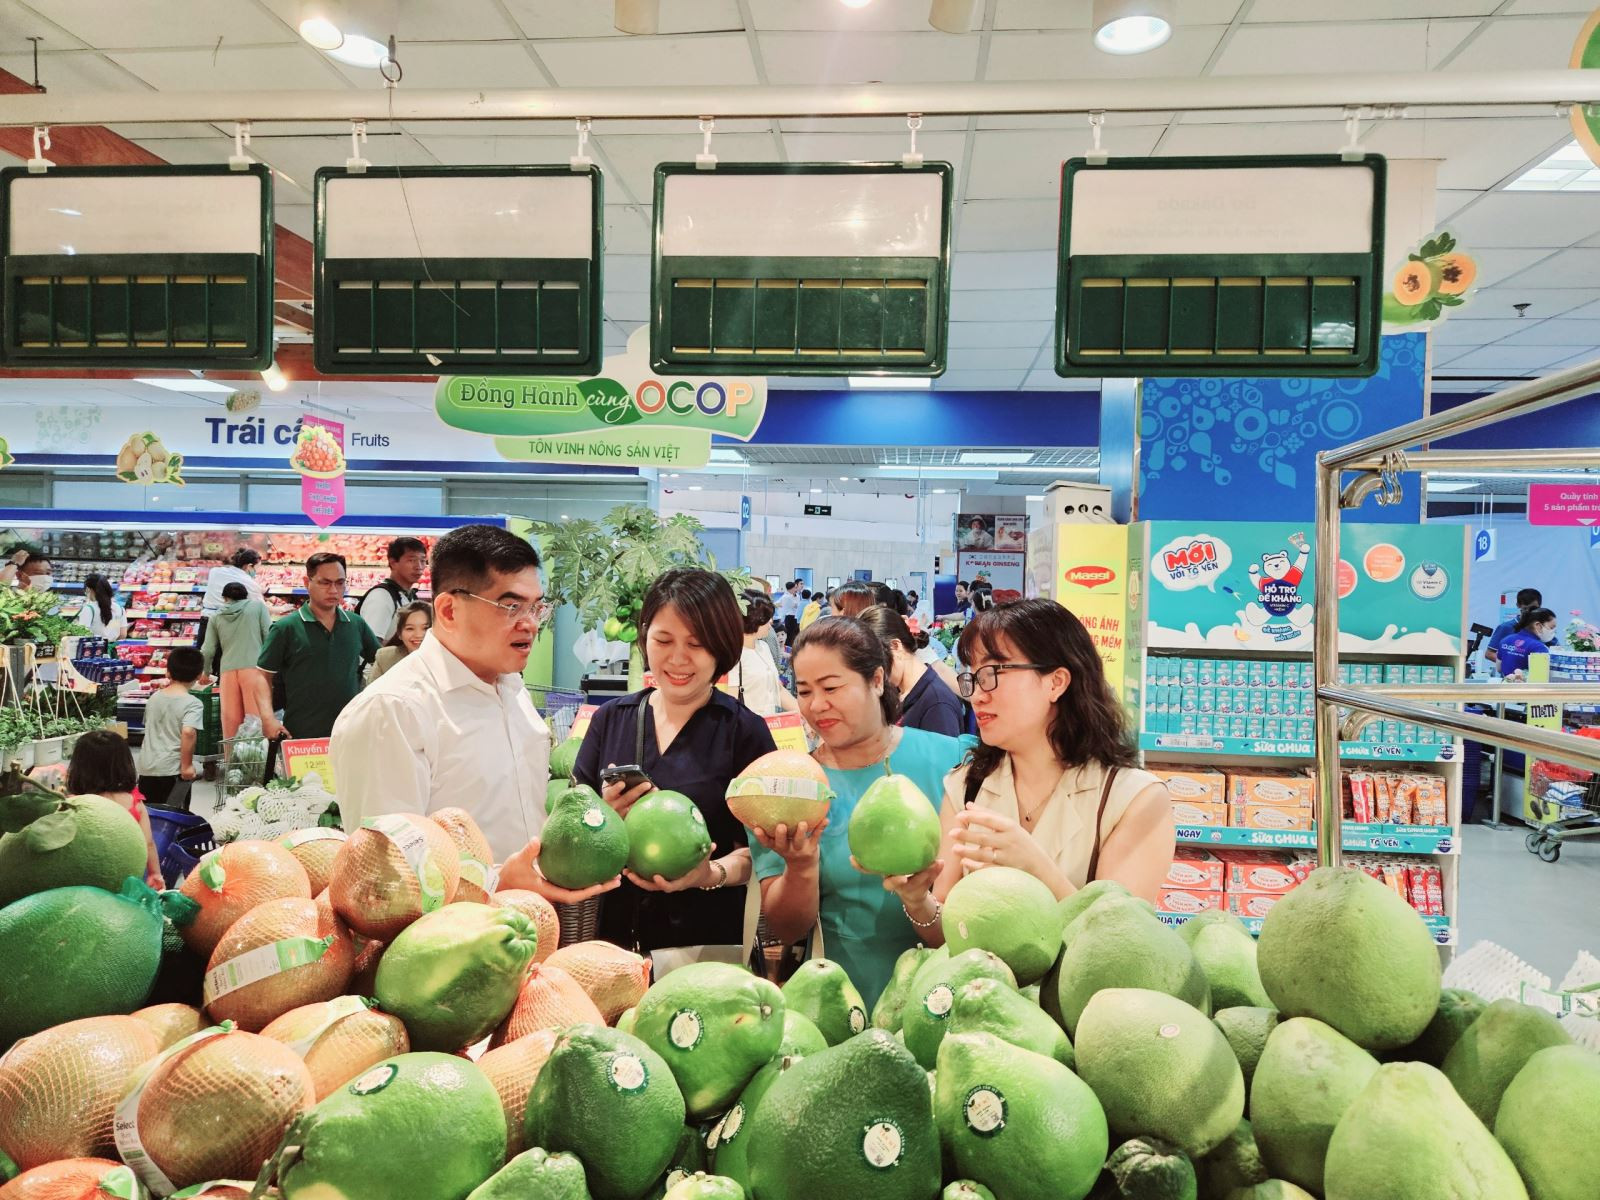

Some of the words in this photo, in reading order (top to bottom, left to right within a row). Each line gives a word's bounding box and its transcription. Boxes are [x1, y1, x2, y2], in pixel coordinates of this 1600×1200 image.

[460, 377, 515, 408] Đồng
[520, 382, 578, 406] Hành
[586, 391, 632, 423] cùng
[635, 379, 753, 417] OCOP
[205, 416, 265, 444] Trái
[352, 433, 390, 447] Fruits
[528, 438, 552, 454] TÔN
[555, 442, 585, 456] VINH
[588, 440, 622, 457] NÔNG
[626, 440, 650, 458] SẢN
[654, 443, 681, 463] VIỆT
[1478, 536, 1488, 550] 18
[1164, 541, 1217, 571] MỚI
[1177, 829, 1201, 838] NGAY
